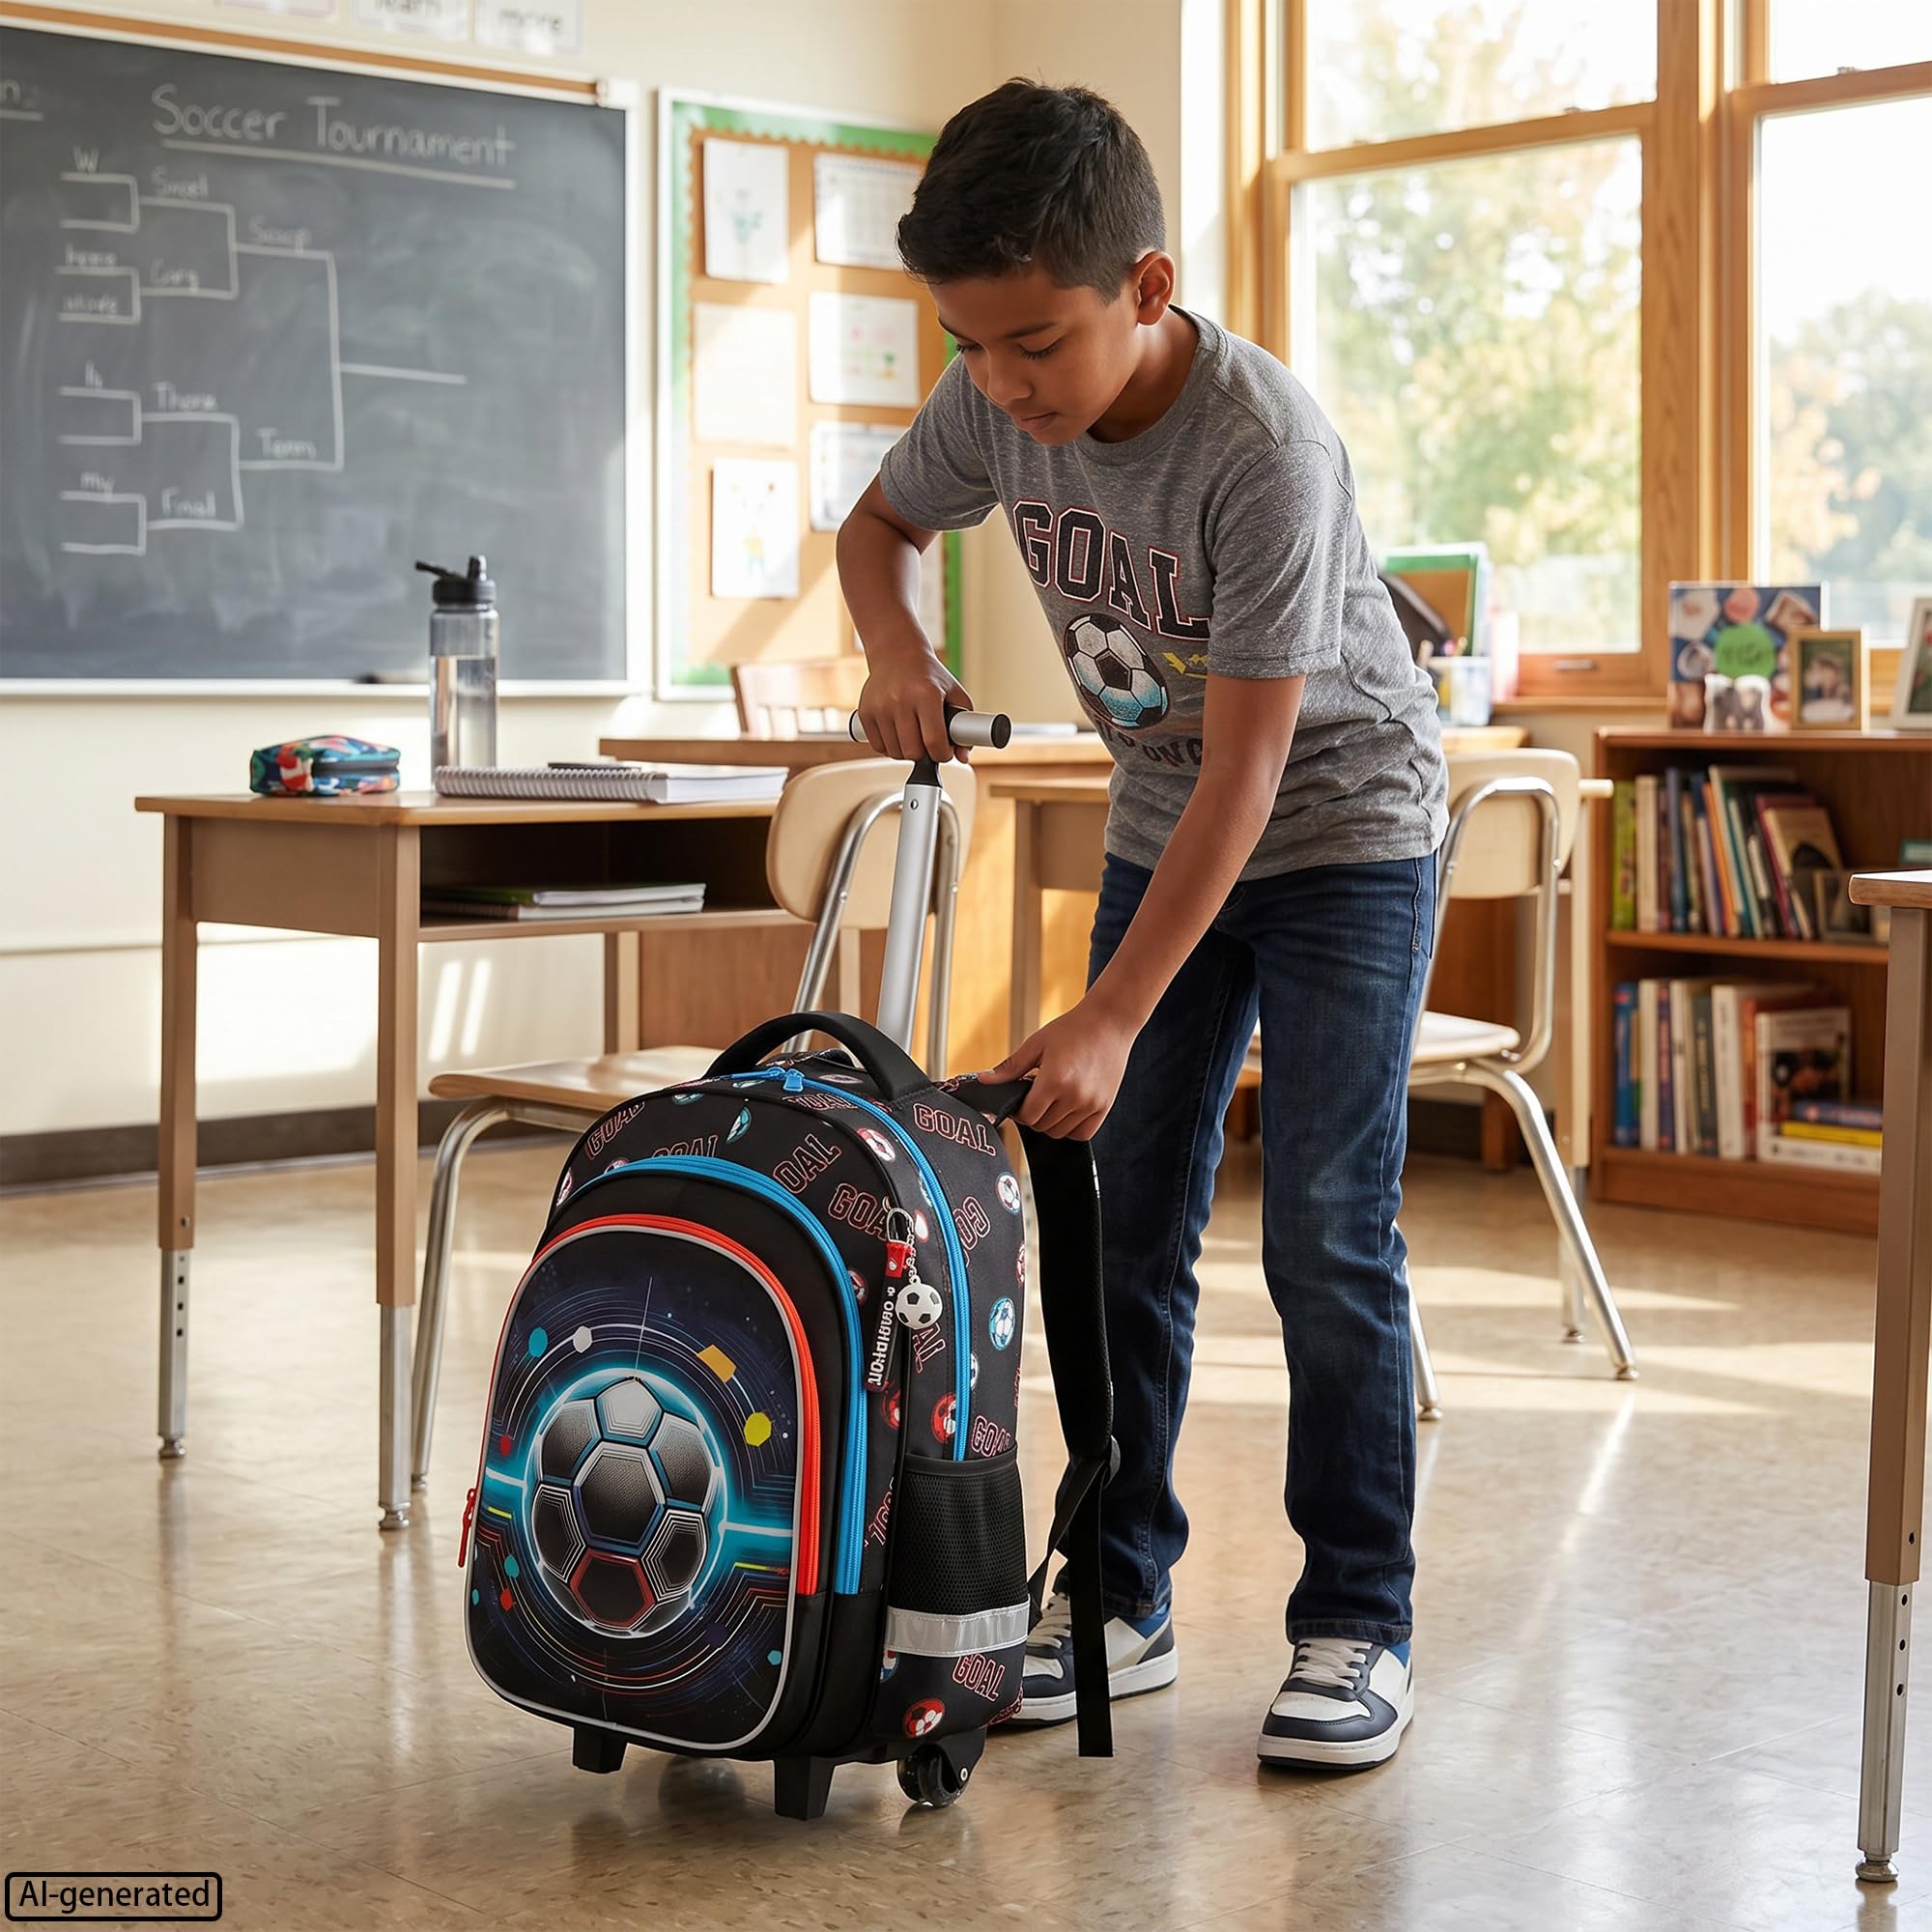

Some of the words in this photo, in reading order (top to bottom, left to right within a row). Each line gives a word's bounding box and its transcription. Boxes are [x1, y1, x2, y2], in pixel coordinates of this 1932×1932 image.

[151, 83, 287, 141] Soccer
[305, 96, 516, 167] Tournament
[1012, 498, 1211, 642] GOAL
[913, 1103, 996, 1156] GOAL
[773, 1133, 842, 1194] OAL
[827, 1182, 890, 1241] GOA
[952, 1653, 1006, 1702] GOAL
